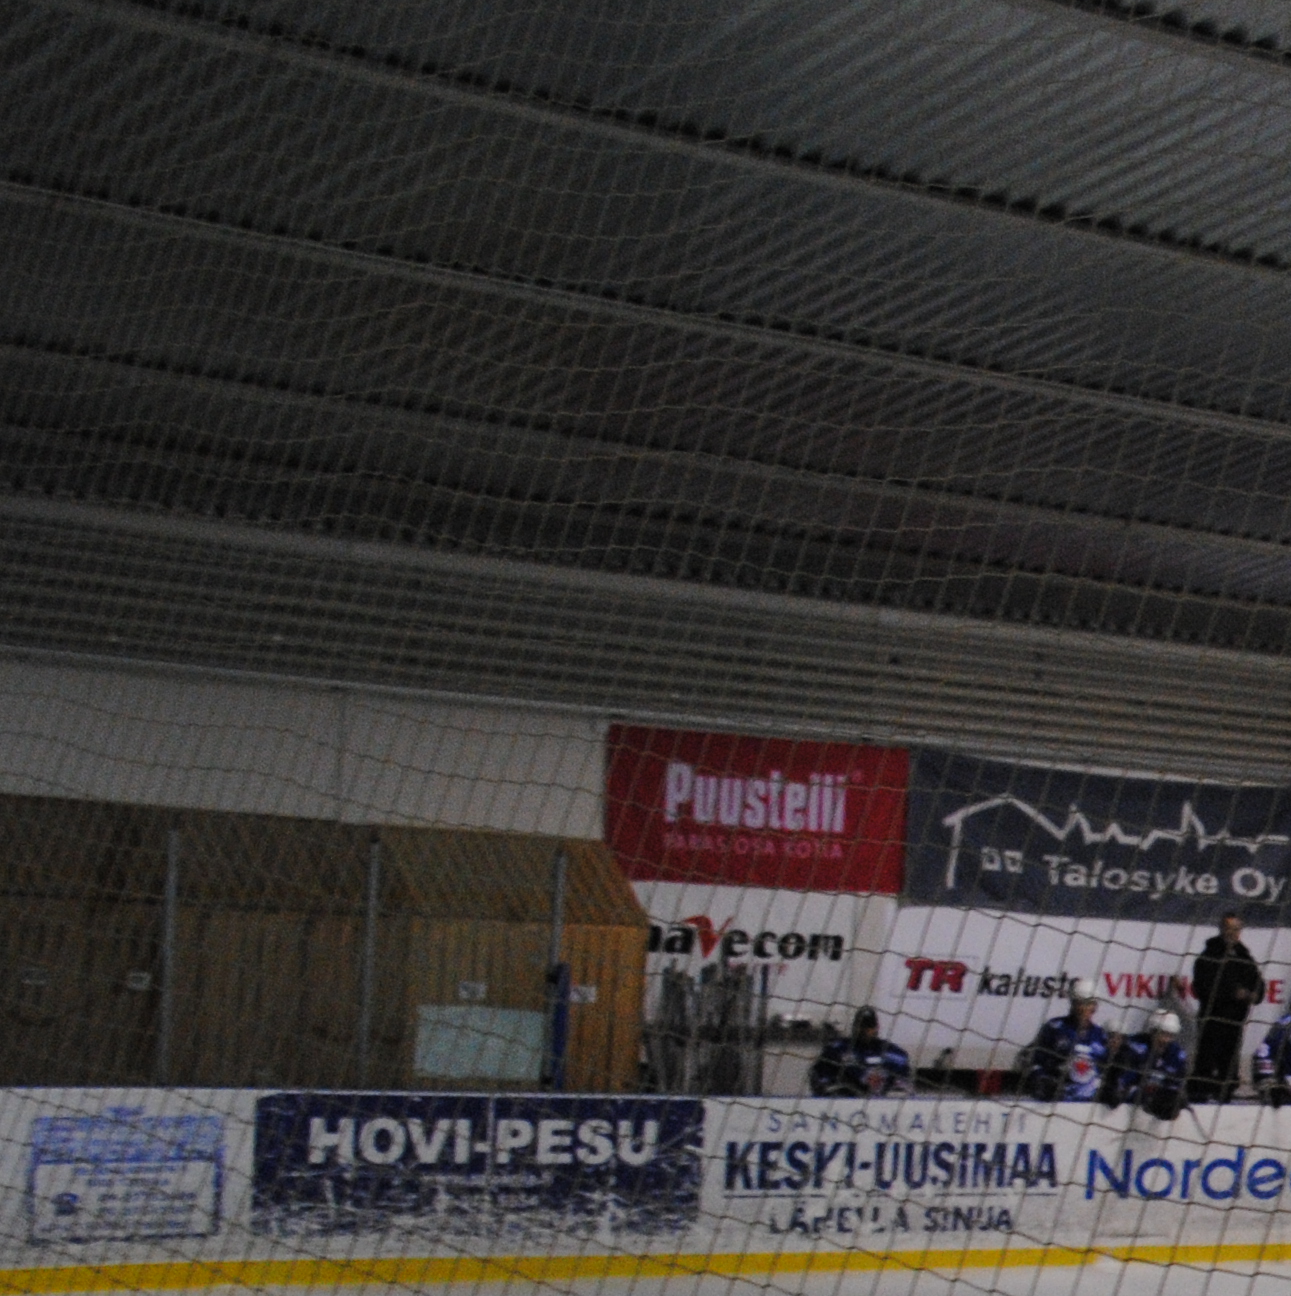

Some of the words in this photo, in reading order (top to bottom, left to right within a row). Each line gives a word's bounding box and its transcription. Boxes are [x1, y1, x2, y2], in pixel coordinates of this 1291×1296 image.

[663, 760, 847, 834] Puustelli
[1042, 852, 1220, 900] Talosyke
[1231, 866, 1288, 902] Oy
[904, 957, 968, 994] TR
[307, 1115, 660, 1167] HOVI-PESU
[723, 1140, 1059, 1192] KESKI-UUSIMAA
